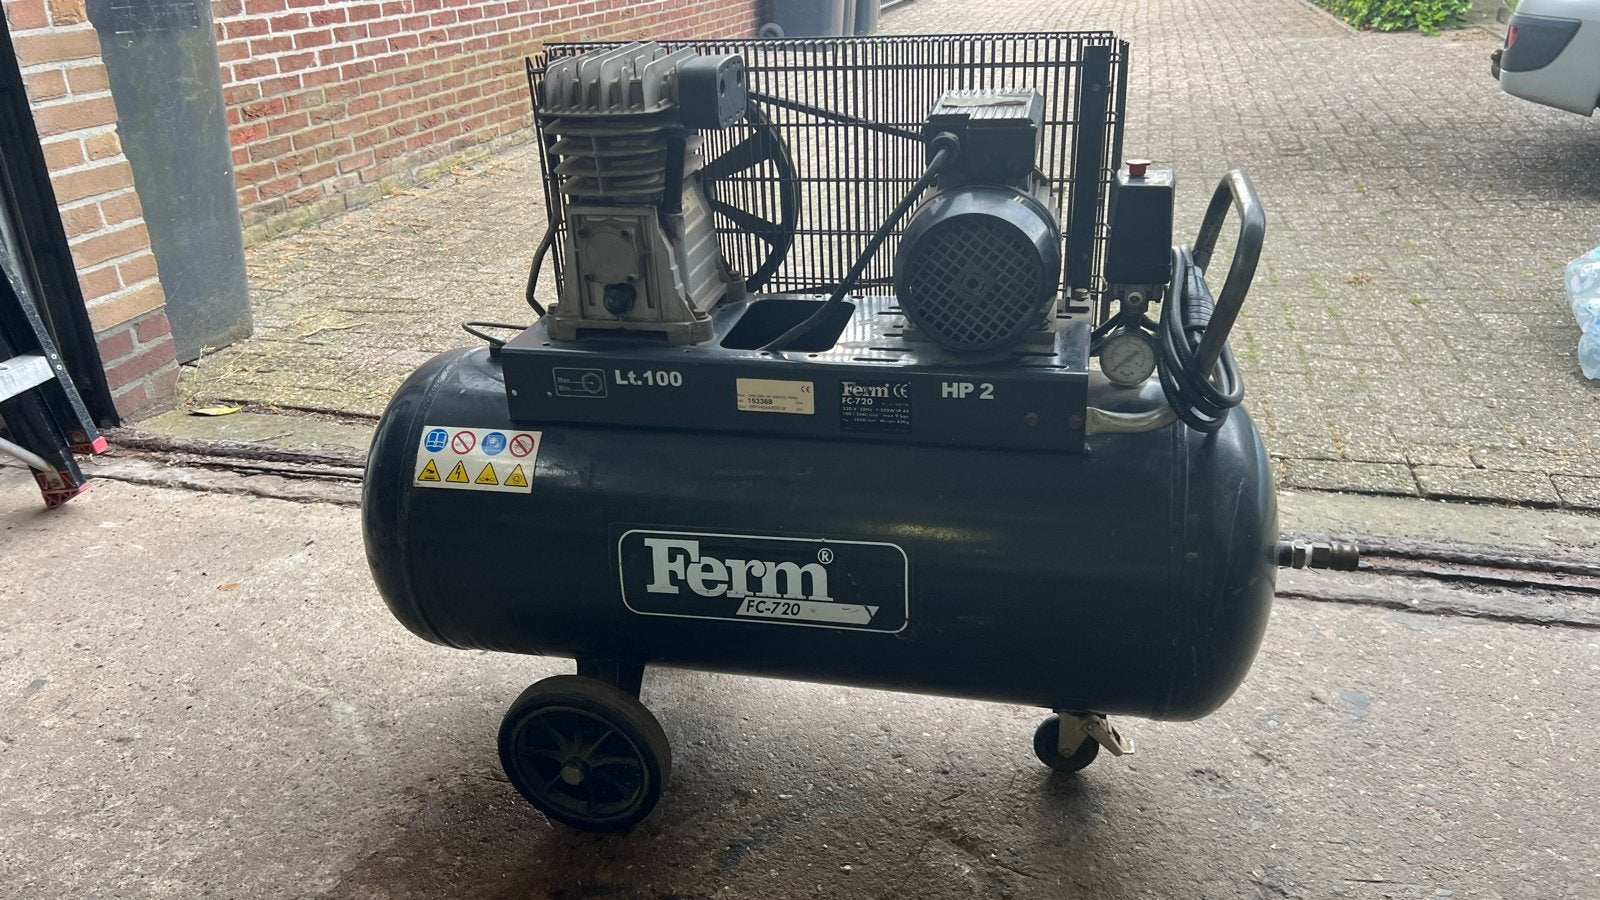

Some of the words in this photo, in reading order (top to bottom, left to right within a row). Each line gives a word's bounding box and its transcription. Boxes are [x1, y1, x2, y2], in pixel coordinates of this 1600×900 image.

[614, 369, 683, 387] Lt.100
[941, 382, 975, 399] HP
[979, 382, 995, 400] 2
[842, 397, 873, 406] FC-720
[643, 537, 834, 602] Ferm
[745, 599, 801, 617] FC-720
